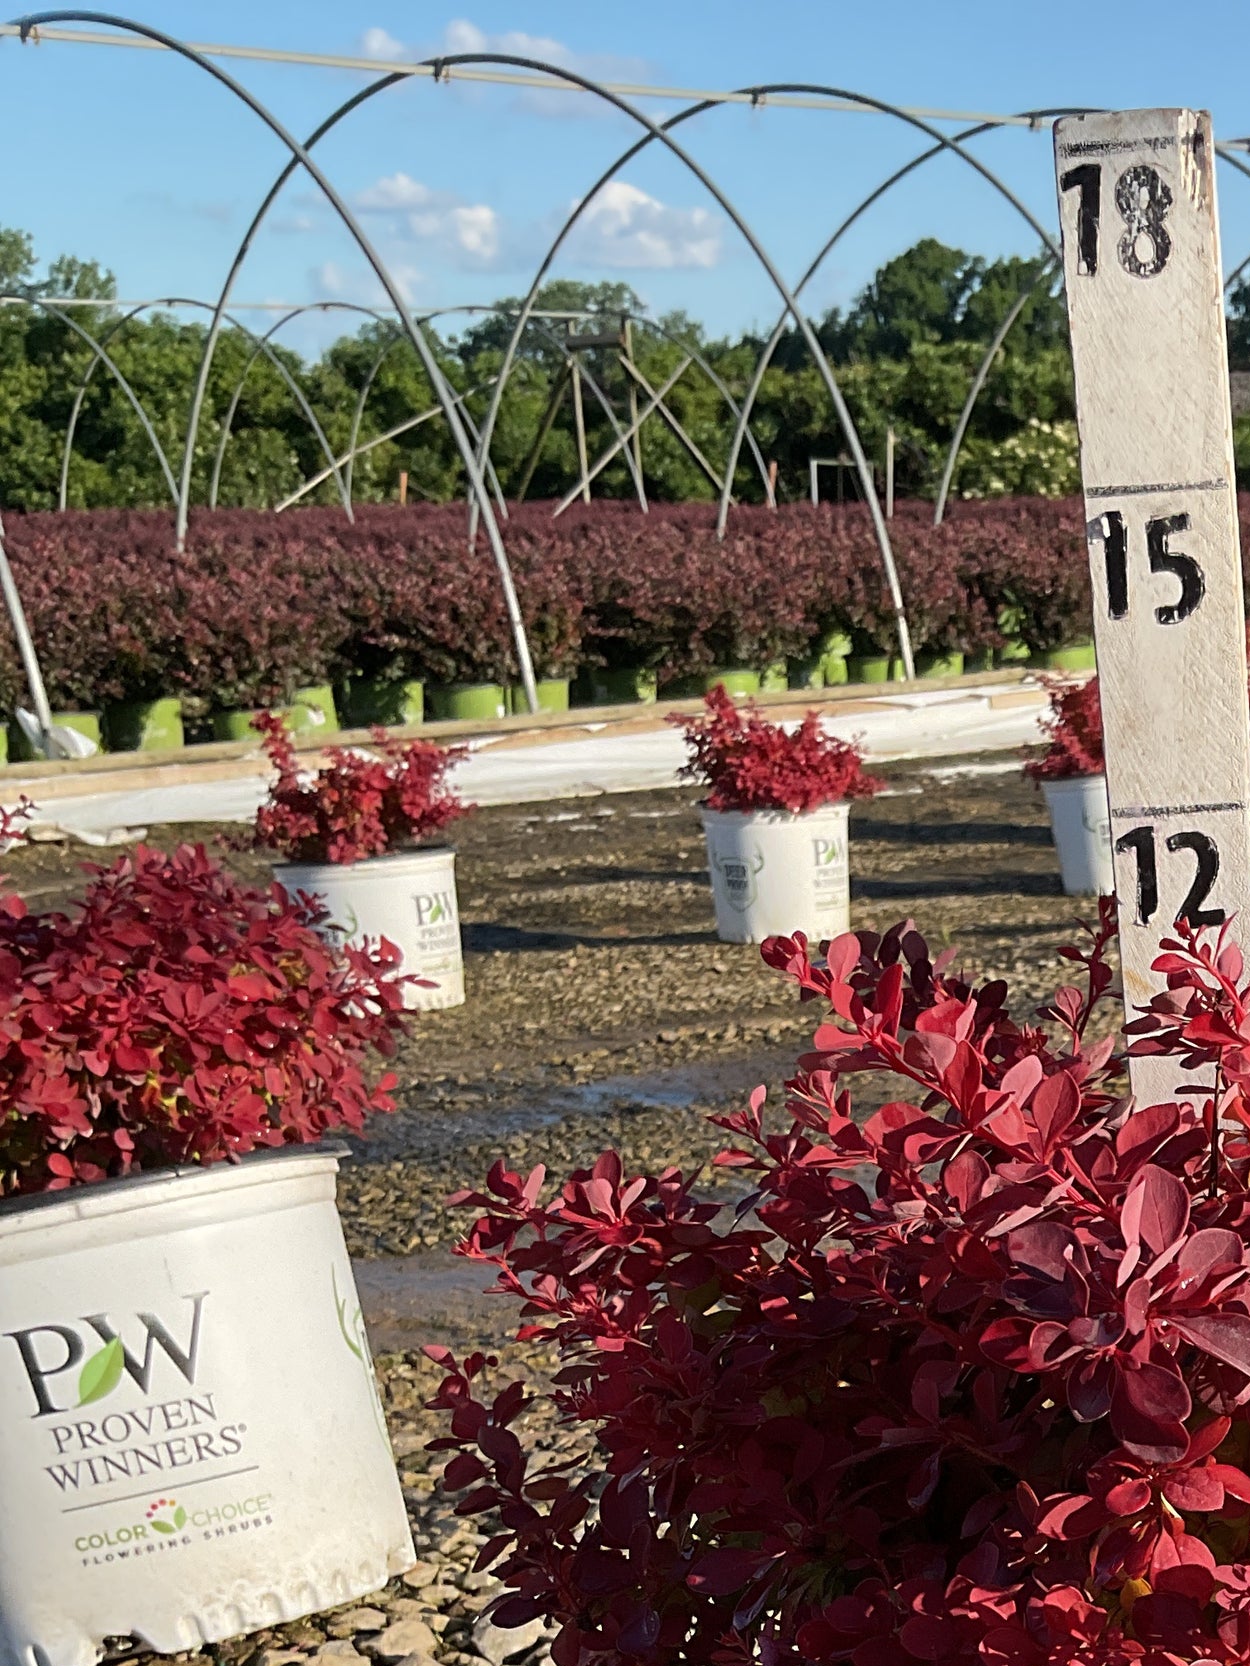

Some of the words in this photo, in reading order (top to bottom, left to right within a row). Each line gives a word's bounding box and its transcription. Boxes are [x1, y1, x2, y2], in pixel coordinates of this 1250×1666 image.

[1060, 163, 1173, 280] 18
[1087, 510, 1206, 626] 15
[1115, 826, 1226, 929] 12
[2, 1291, 210, 1419] PW
[51, 1392, 218, 1455] PROVEN
[74, 1524, 149, 1552] COLOR
[82, 1536, 192, 1567] FLOWERING
[203, 1514, 274, 1541] SHRUBS
